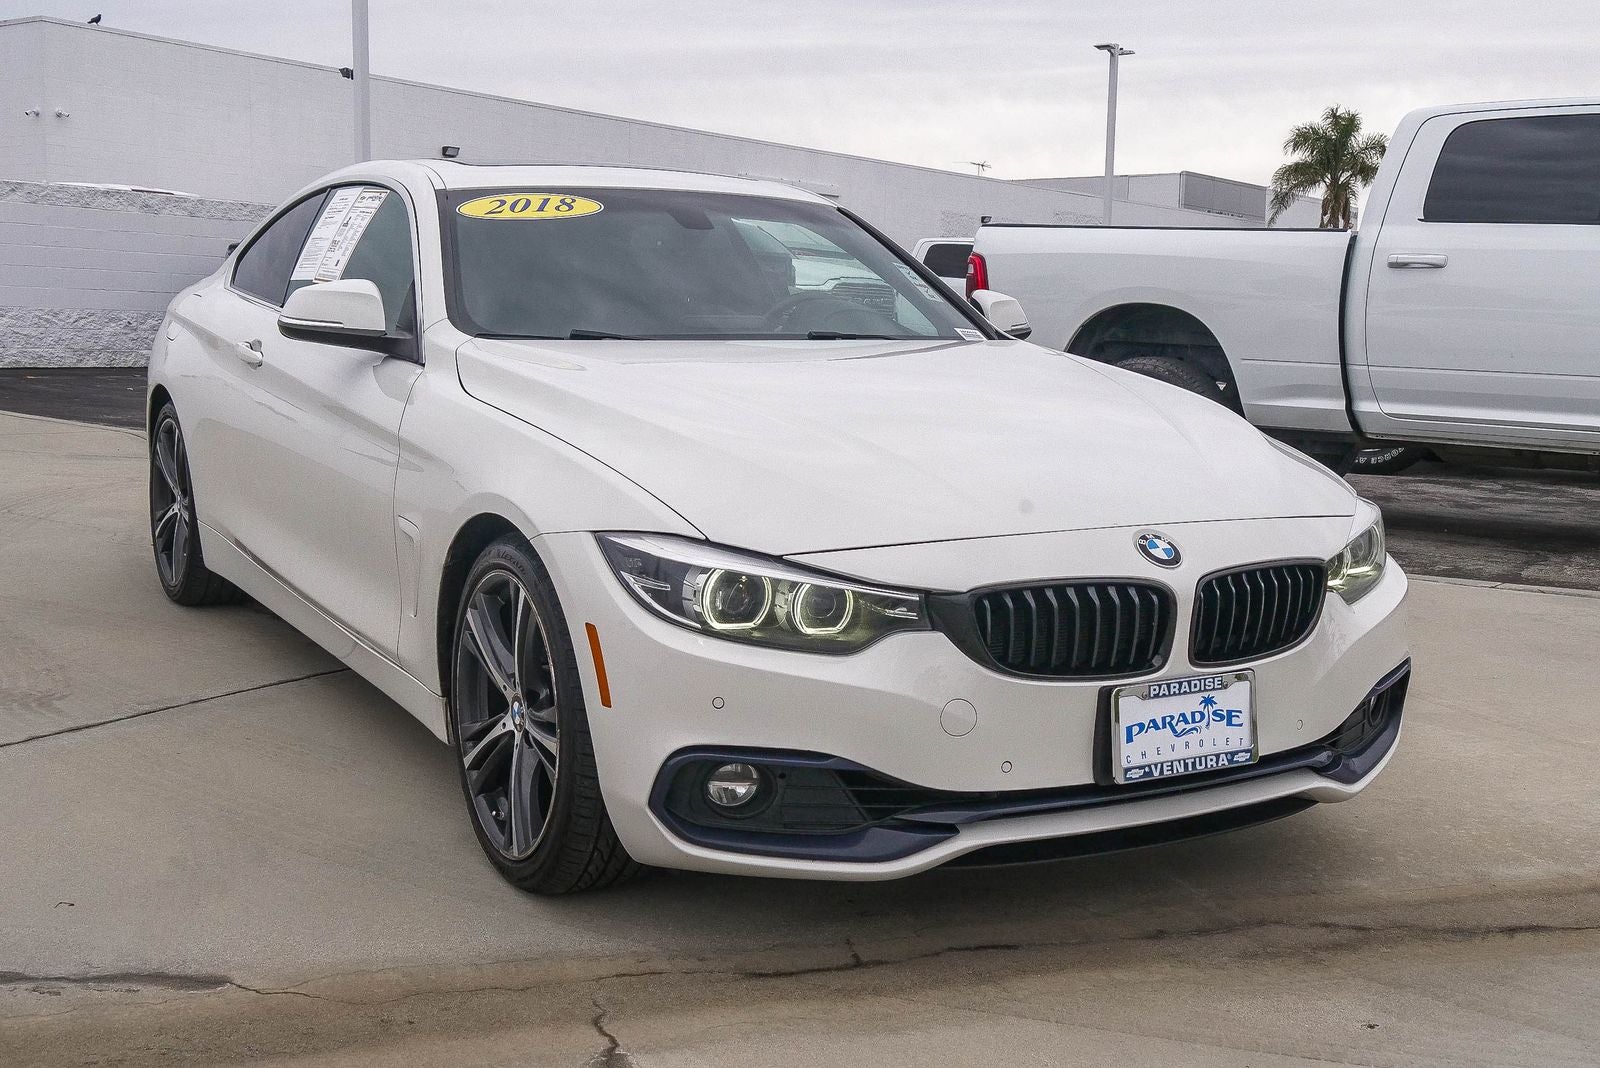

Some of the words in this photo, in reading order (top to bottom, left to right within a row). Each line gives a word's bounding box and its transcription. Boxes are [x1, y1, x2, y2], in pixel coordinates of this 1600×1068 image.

[484, 197, 577, 215] 2018
[1150, 677, 1222, 698] PARADISE
[1125, 694, 1244, 744] PARADISE
[1126, 737, 1244, 764] CHEVROLET
[1151, 754, 1229, 777] VENTURA
